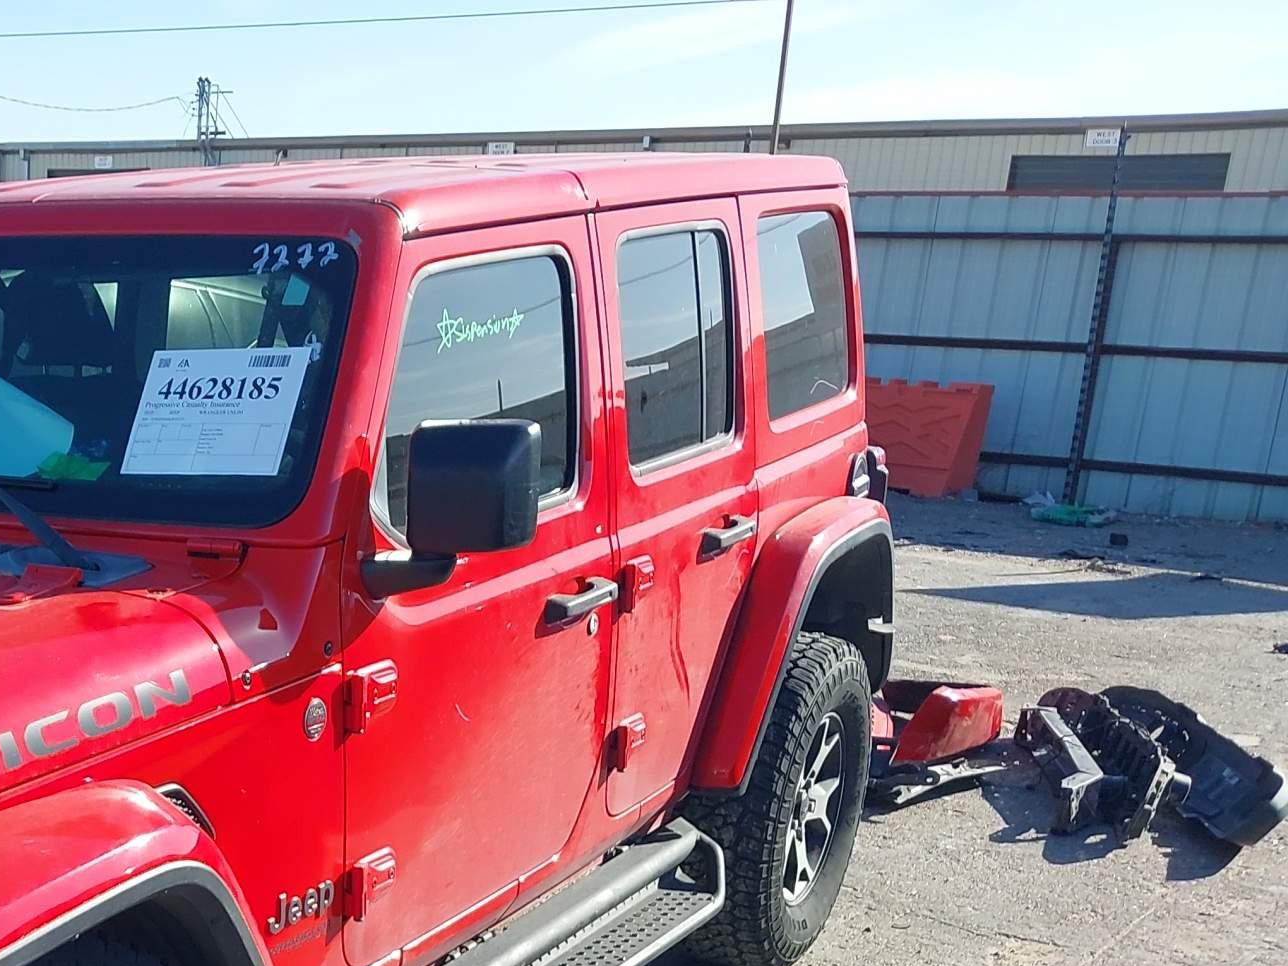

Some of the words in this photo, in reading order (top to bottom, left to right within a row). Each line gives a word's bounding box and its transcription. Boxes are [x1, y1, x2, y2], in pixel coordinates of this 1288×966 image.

[158, 376, 283, 401] 44628185
[181, 401, 208, 409] Casualty
[209, 401, 241, 409] Insurance
[267, 880, 334, 935] Jeep
